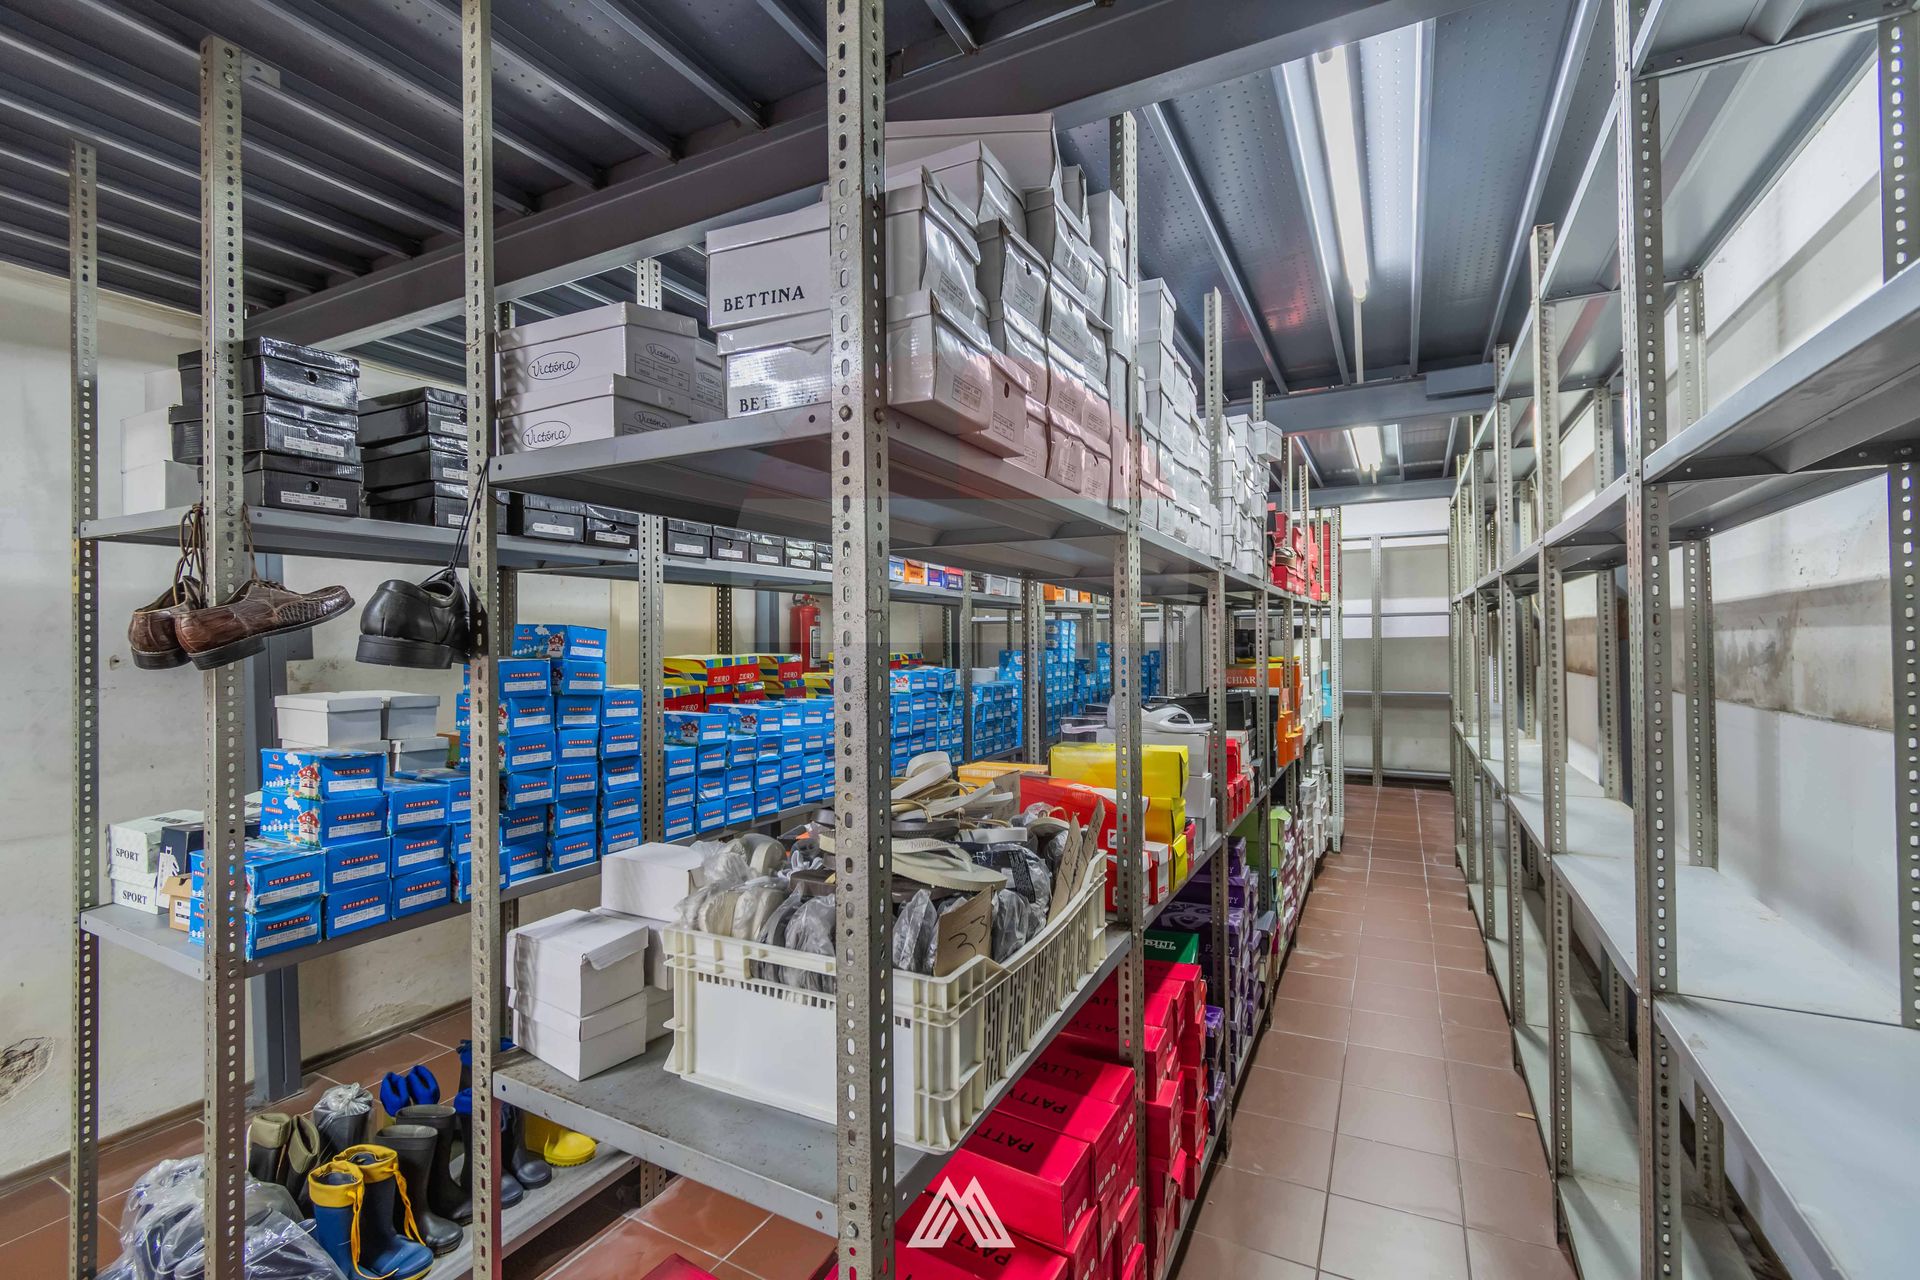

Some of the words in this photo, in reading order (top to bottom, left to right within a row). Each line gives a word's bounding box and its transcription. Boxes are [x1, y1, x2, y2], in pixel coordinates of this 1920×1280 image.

[724, 286, 805, 312] BETTINA
[532, 360, 576, 377] Victória
[525, 429, 567, 446] Victória
[714, 675, 730, 683] ZERO
[1226, 676, 1256, 684] CHIAR
[337, 812, 375, 821] SHISHANG
[115, 847, 140, 862] SPORT
[341, 854, 379, 866] SHISHANG
[268, 872, 312, 886] SHISHANG
[122, 890, 148, 905] SPORT
[342, 896, 379, 910] SHISHANG
[267, 915, 311, 930] SHISHANG
[1036, 1061, 1085, 1080] ATTY
[973, 1126, 1034, 1154] PATT
[950, 1231, 1012, 1267] PATT
